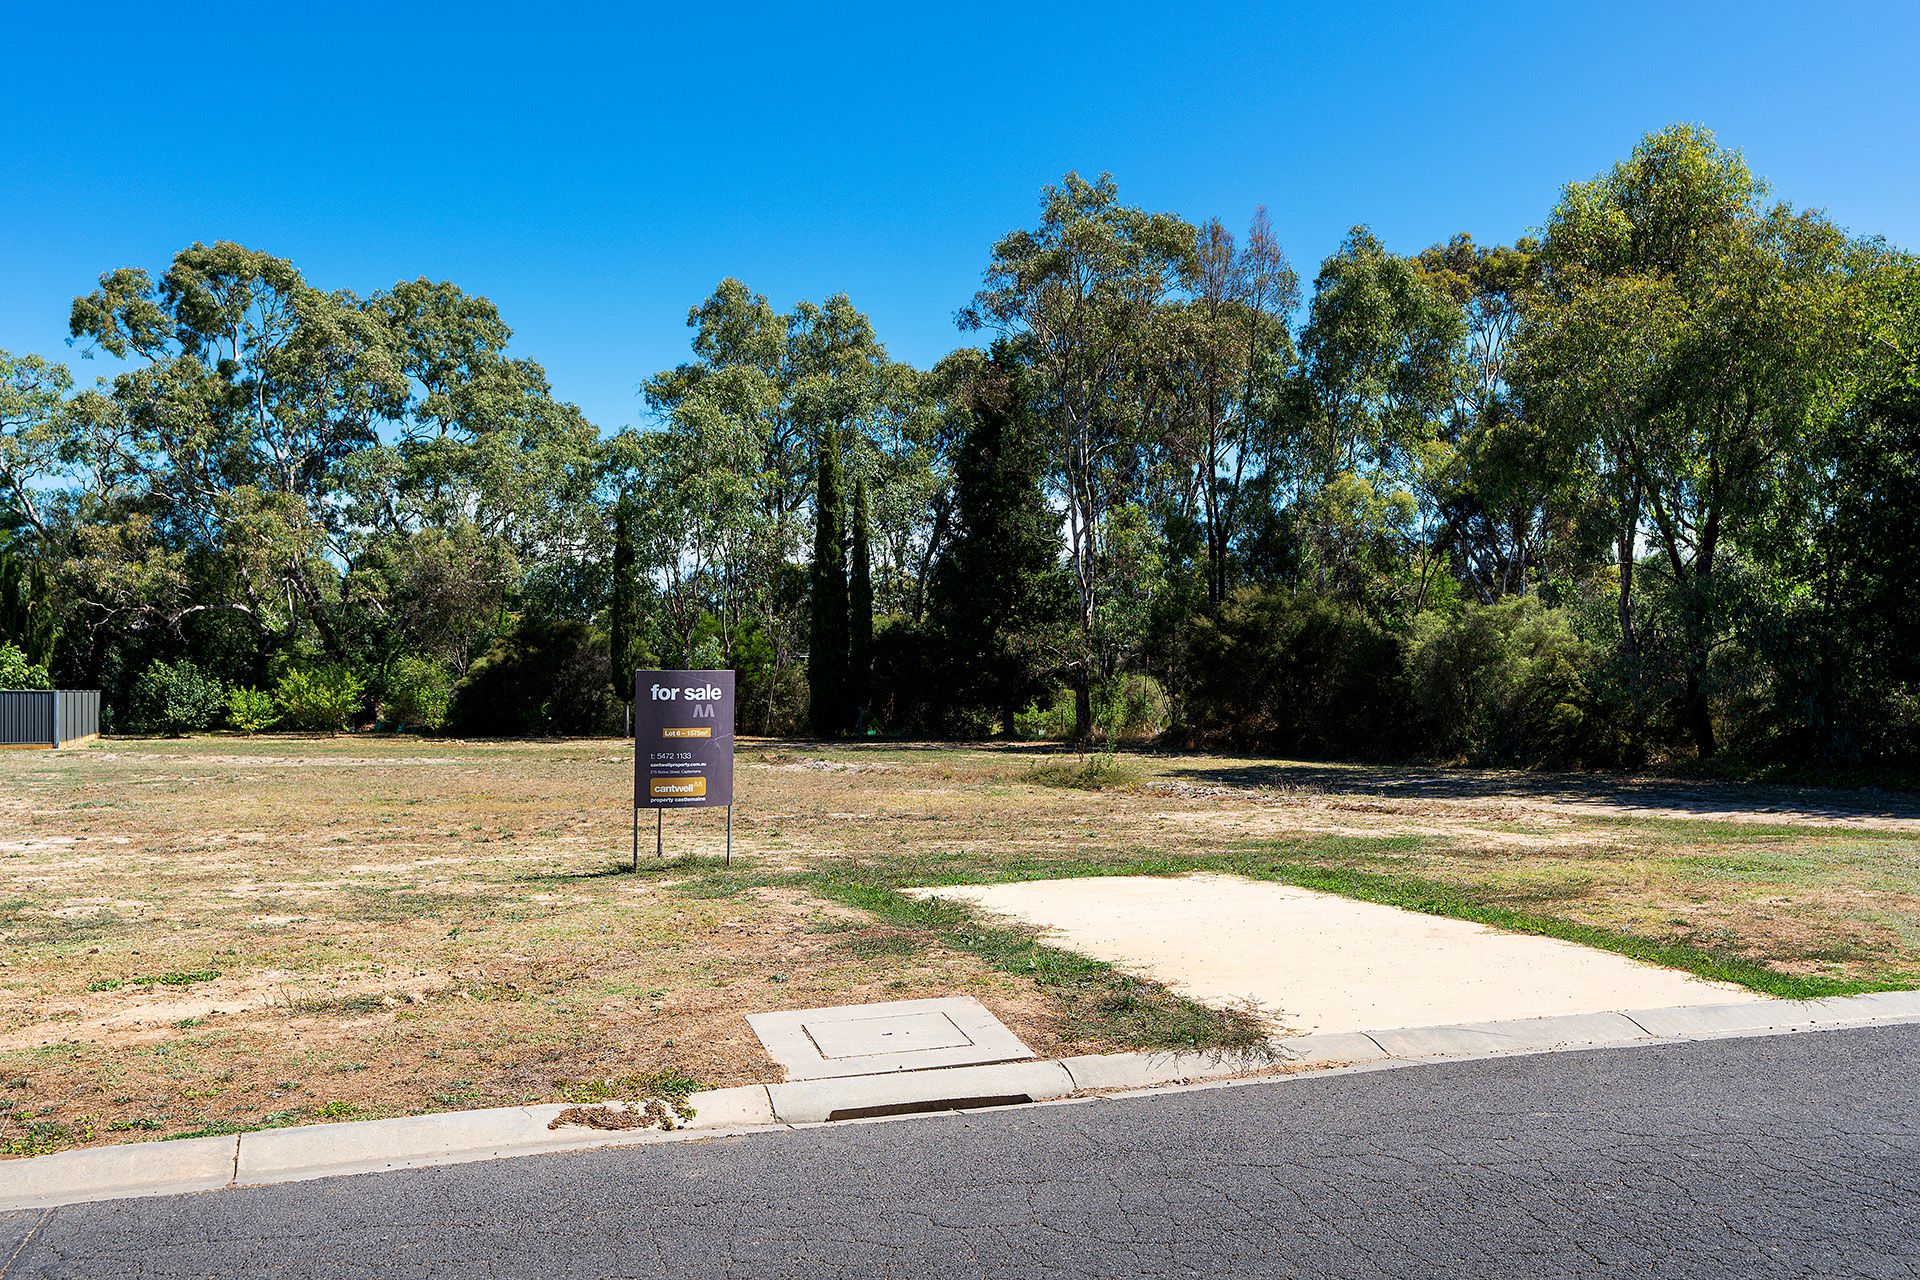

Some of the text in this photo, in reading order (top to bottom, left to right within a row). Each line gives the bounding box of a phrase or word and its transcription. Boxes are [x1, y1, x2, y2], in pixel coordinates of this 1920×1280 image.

[651, 684, 722, 700] for sale
[654, 784, 694, 792] cantwell
